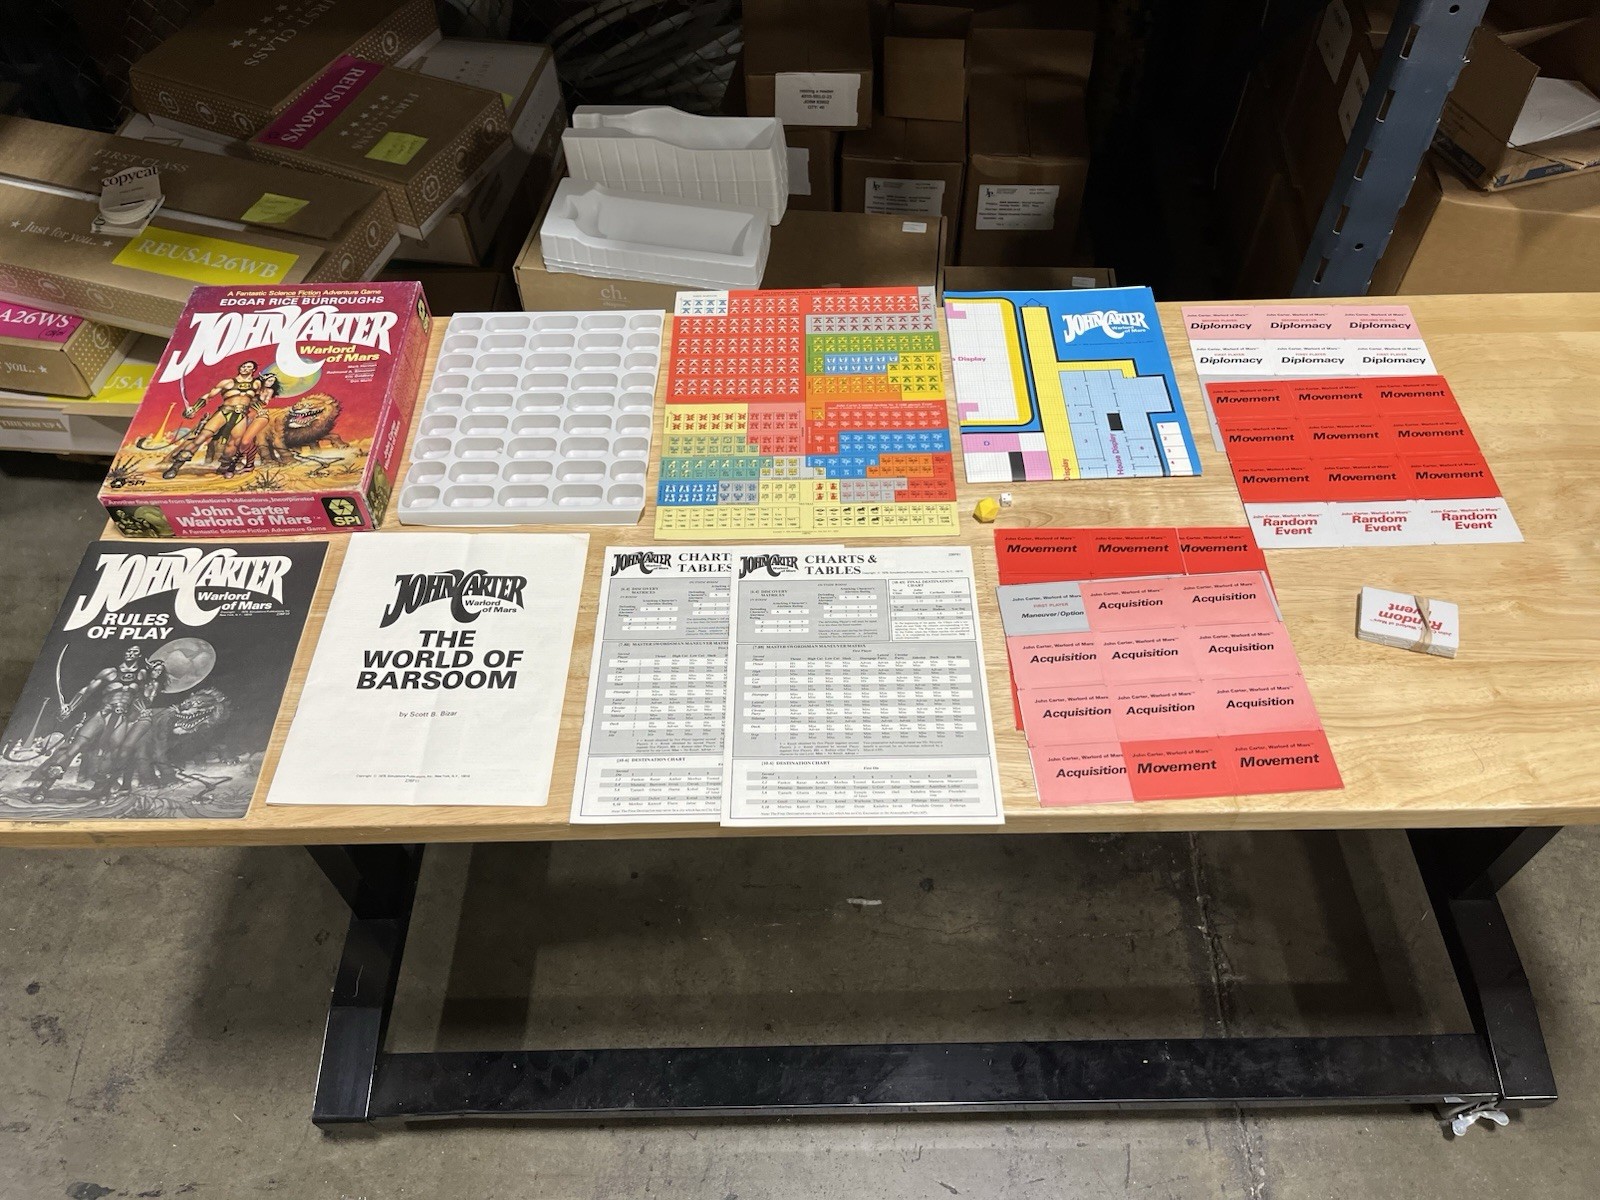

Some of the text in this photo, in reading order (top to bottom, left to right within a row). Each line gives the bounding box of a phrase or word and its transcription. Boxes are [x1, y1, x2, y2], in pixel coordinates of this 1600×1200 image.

[244, 29, 296, 66] CLASS
[281, 68, 366, 142] REUSA26WS
[94, 149, 141, 162] FIRST
[102, 166, 157, 187] copycat
[21, 221, 50, 234] Just
[50, 227, 69, 238] for
[136, 238, 279, 278] REUSA26WB
[1062, 310, 1149, 344] JOHN CARTER
[1190, 322, 1252, 330] Diplomacy
[1270, 322, 1332, 330] Diplomacy
[1349, 322, 1411, 330] Diplomacy
[158, 305, 398, 383] JOHN CARTER
[300, 345, 356, 354] Warlord
[326, 353, 380, 362] of Mars
[1200, 356, 1263, 364] Diplomacy
[1281, 356, 1345, 364] Diplomacy
[1362, 356, 1426, 364] Diplomacy
[1216, 394, 1280, 404] Movement
[1298, 392, 1363, 401] Movement
[1380, 389, 1445, 399] Movement
[1229, 433, 1295, 442] Movement
[1313, 431, 1380, 440] Movement
[1398, 428, 1465, 438] Movement
[1110, 433, 1124, 475] House Display
[1242, 474, 1310, 483] Movement
[1328, 472, 1397, 482] Movement
[1415, 470, 1484, 480] Movement
[191, 505, 290, 516] John Carter
[176, 514, 312, 528] Warlord of Mars
[334, 516, 362, 526] SPI
[1263, 517, 1317, 526] Random
[1352, 514, 1407, 524] Random
[1441, 512, 1497, 521] Random
[1275, 526, 1313, 535] Event
[1364, 524, 1402, 532] Event
[1455, 521, 1493, 530] Event
[1007, 544, 1077, 553] Movement
[1098, 544, 1169, 553] Movement
[1180, 544, 1248, 553] Movement
[678, 553, 732, 562] CHART
[805, 555, 865, 564] CHARTS
[611, 551, 672, 576] JOHN CARTER
[678, 564, 732, 572] TABLES
[739, 554, 799, 579] JOHN CARTER
[805, 566, 862, 575] TABLES
[63, 547, 292, 632] JOHN CARTER
[198, 592, 251, 601] Warlord
[379, 569, 528, 628] JOHN CARTER
[1192, 592, 1256, 604] Acquisition
[221, 601, 272, 610] of Mars
[1098, 598, 1163, 610] Acquisition
[1388, 603, 1432, 616] vent
[102, 613, 170, 626] RULES
[1378, 610, 1443, 630] Rndom
[87, 627, 174, 639] OF PLAY
[419, 630, 477, 647] THE
[1208, 643, 1274, 654] Acquisition
[363, 650, 524, 668] WORLD OF
[1030, 652, 1097, 664] Acquisition
[1112, 648, 1178, 660] Acquisition
[356, 671, 517, 690] BARSOOM
[1226, 697, 1294, 709] Acquisition
[1043, 706, 1112, 718] Acquisition
[1126, 703, 1195, 715] Acquisition
[1240, 754, 1320, 768] Movement
[1056, 766, 1127, 778] Acquisition
[1137, 760, 1217, 774] Movement
